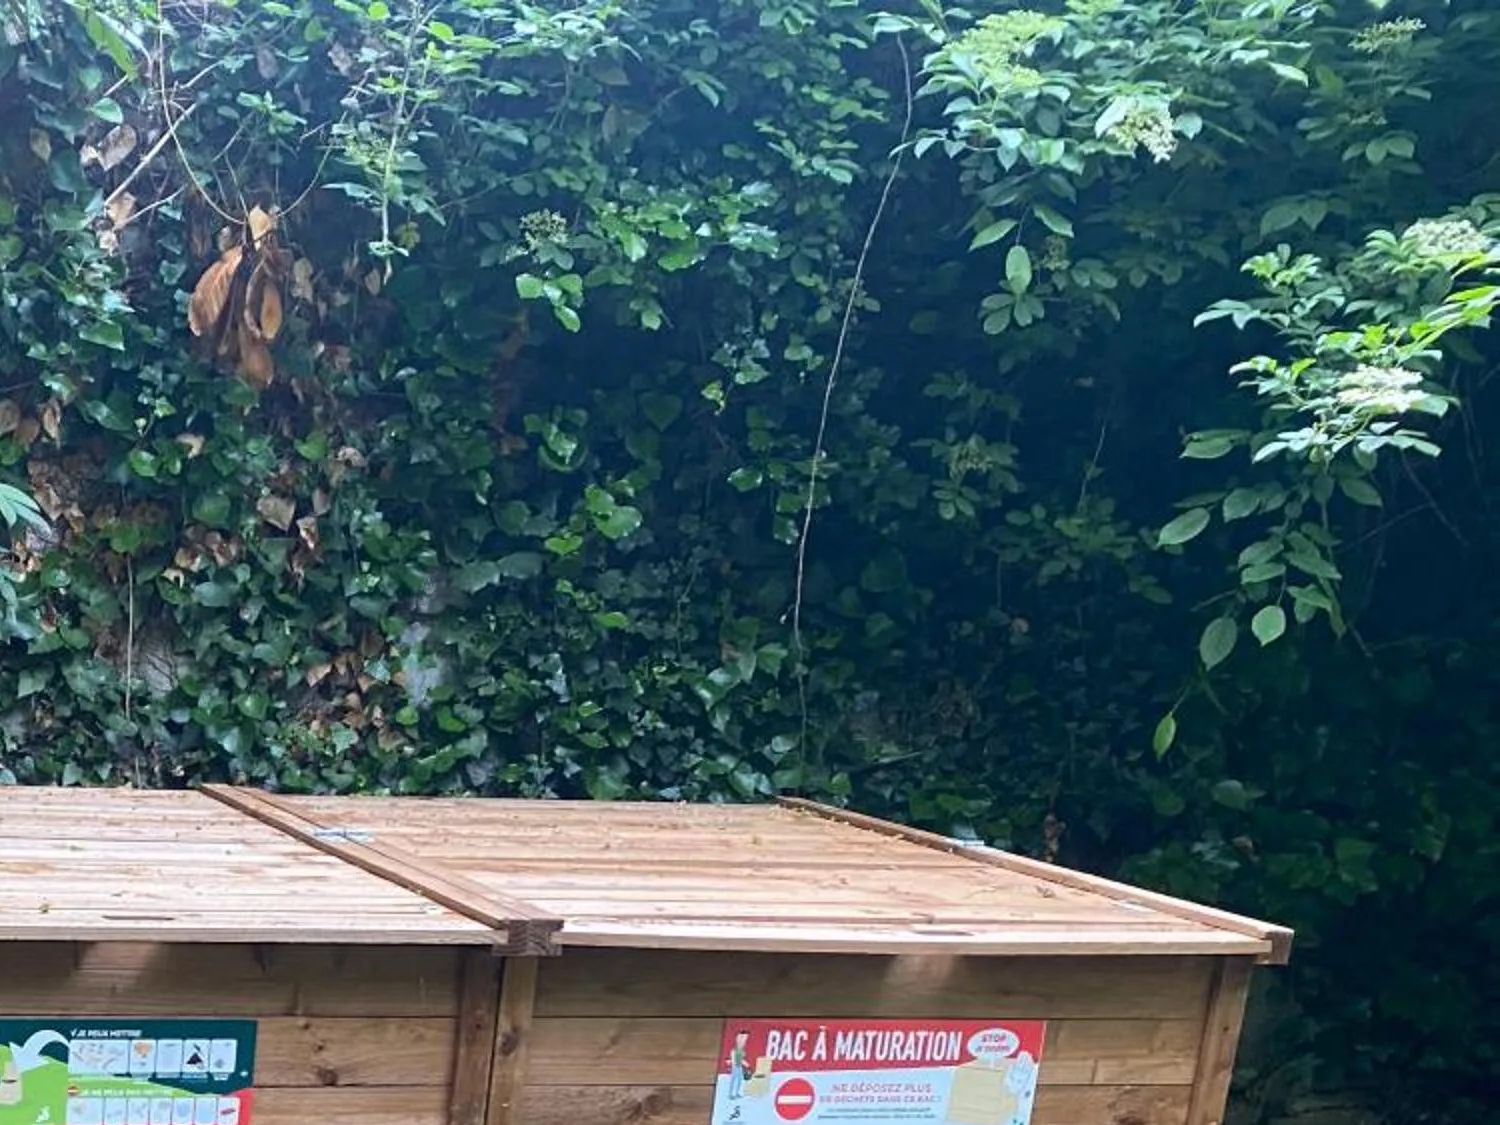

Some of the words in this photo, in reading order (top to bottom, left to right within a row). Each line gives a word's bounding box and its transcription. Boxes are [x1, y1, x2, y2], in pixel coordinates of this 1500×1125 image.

[766, 1030, 809, 1061] BAC
[811, 1025, 827, 1061] À
[833, 1030, 963, 1061] MATURATION
